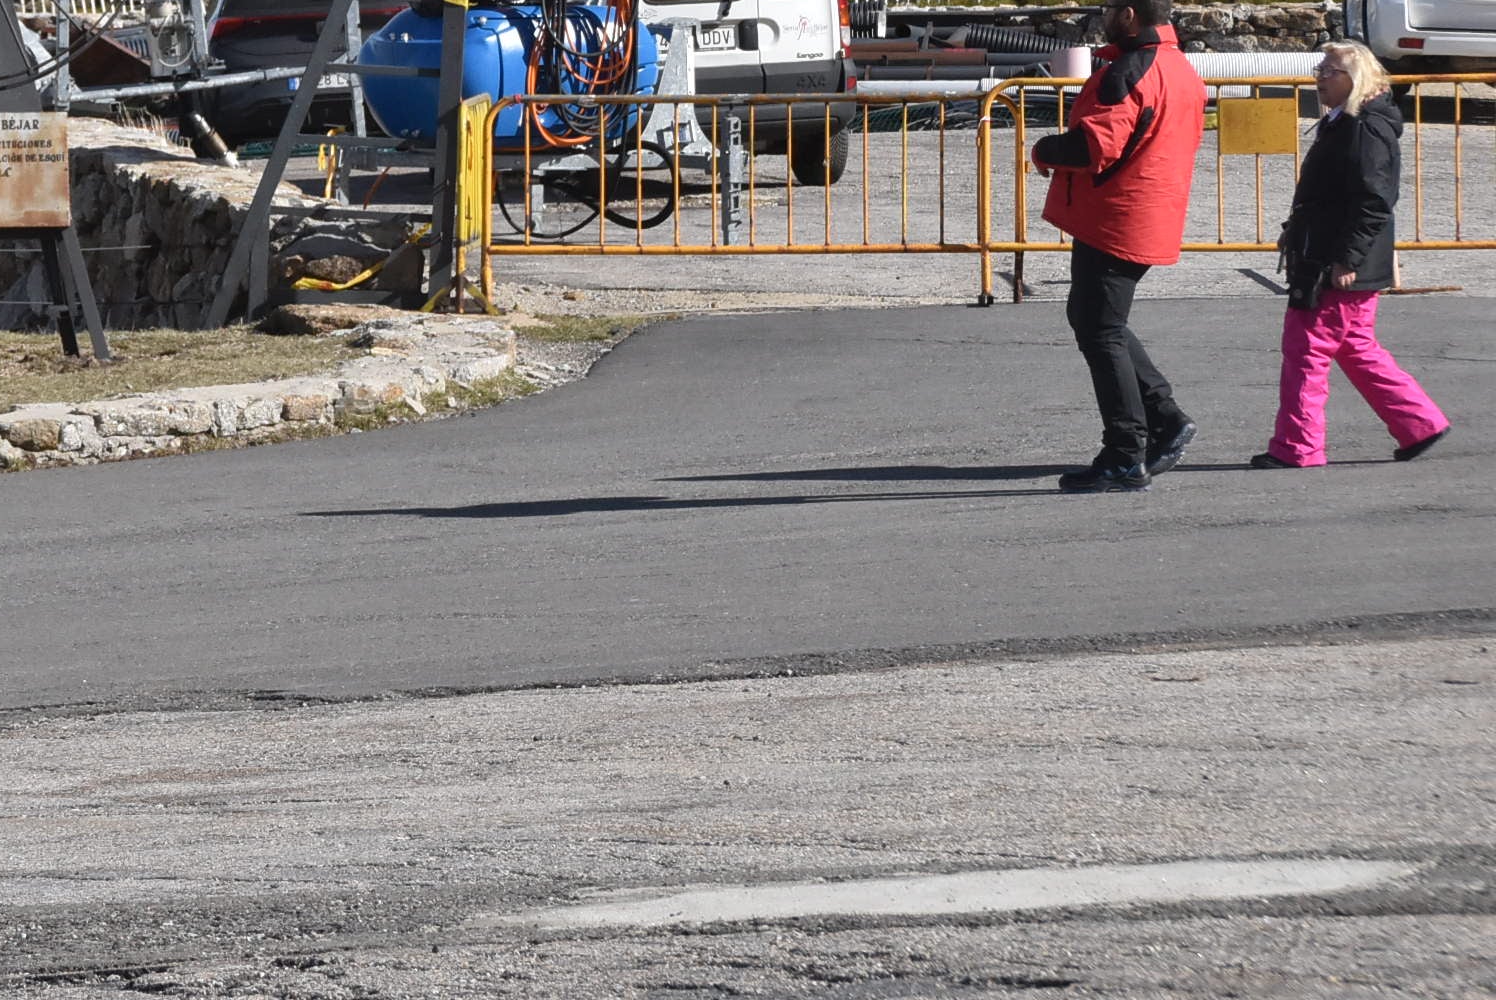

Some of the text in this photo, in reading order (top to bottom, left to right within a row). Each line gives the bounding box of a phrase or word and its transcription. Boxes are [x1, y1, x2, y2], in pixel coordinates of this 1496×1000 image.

[702, 30, 731, 46] DDV
[1, 116, 40, 130] BÉJAR
[24, 154, 36, 163] DE
